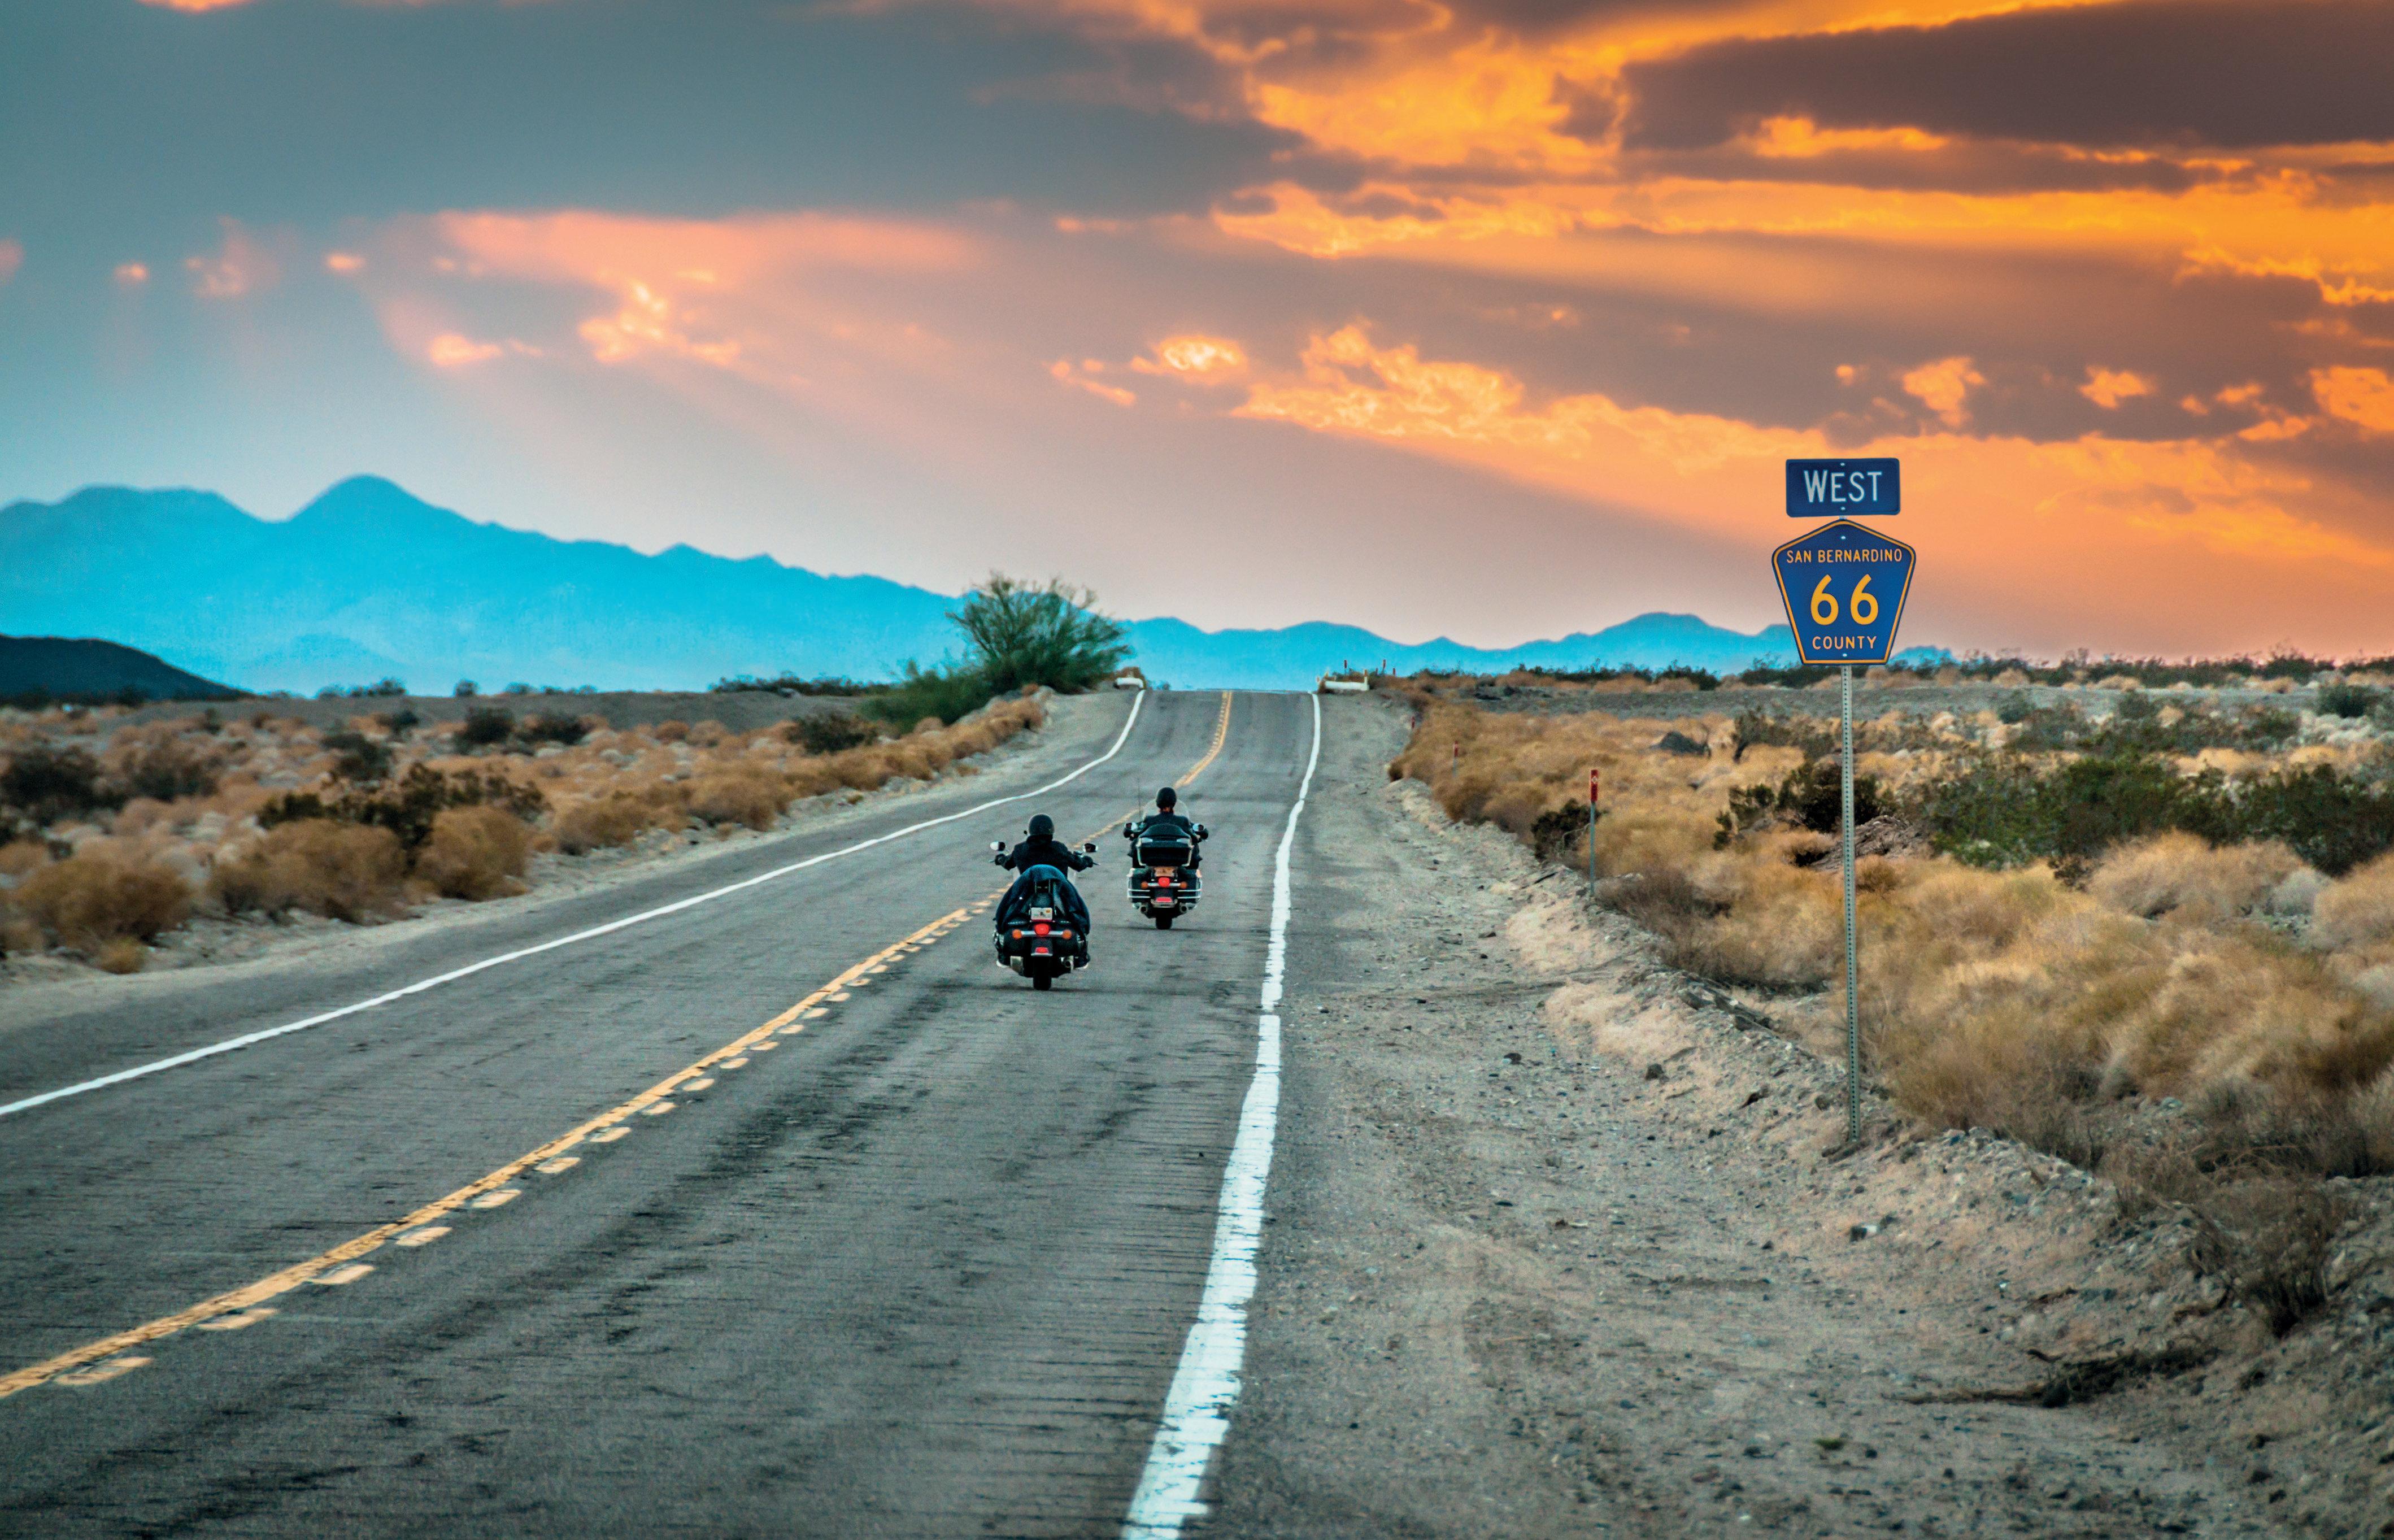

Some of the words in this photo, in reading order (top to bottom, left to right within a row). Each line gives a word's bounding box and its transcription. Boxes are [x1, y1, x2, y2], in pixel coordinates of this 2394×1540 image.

[1804, 470, 1882, 502] WEST
[1786, 550, 1812, 563] SAN
[1818, 549, 1903, 563] BERNARDINO
[1810, 574, 1878, 625] 66
[1812, 636, 1877, 649] COUNTY
